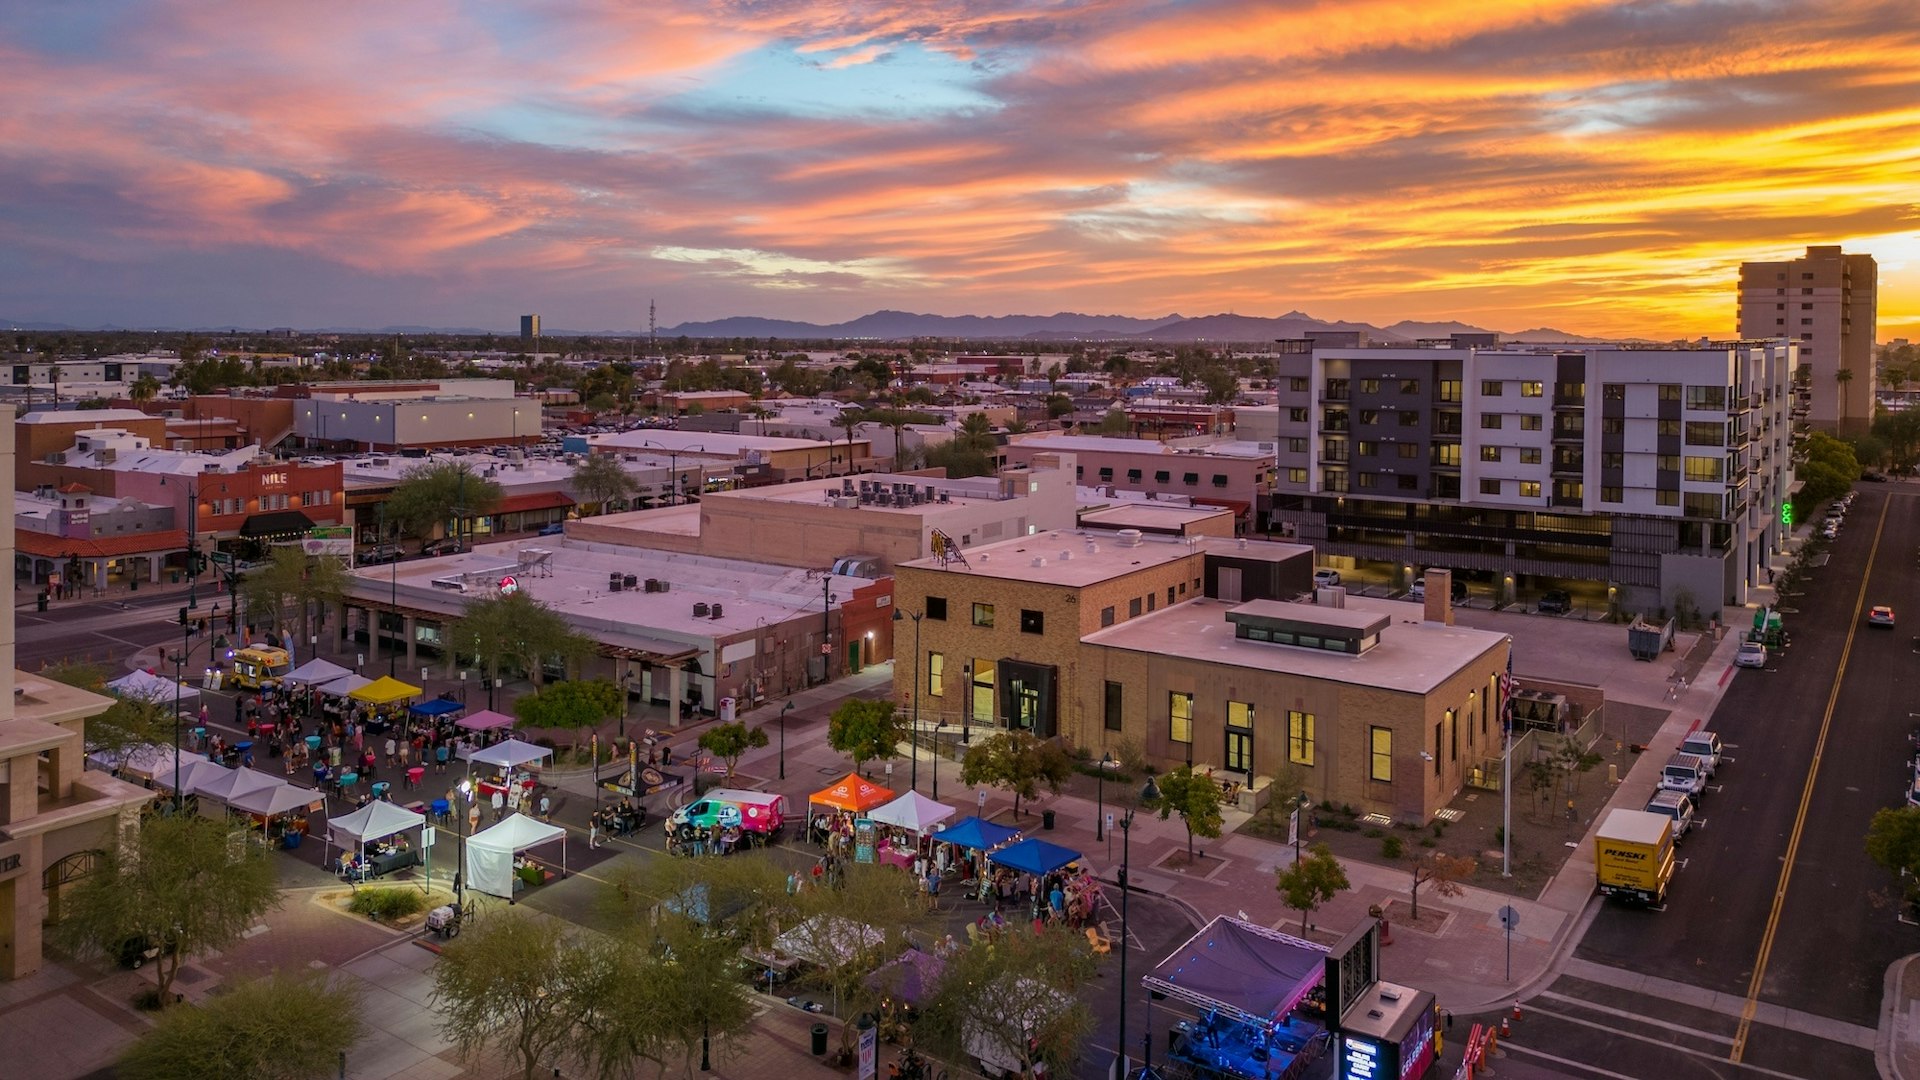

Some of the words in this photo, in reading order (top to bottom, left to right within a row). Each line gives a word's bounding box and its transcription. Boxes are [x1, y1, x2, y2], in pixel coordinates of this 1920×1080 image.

[261, 472, 287, 486] NILE
[1065, 593, 1076, 604] 26
[1604, 848, 1648, 860] PENSKE
